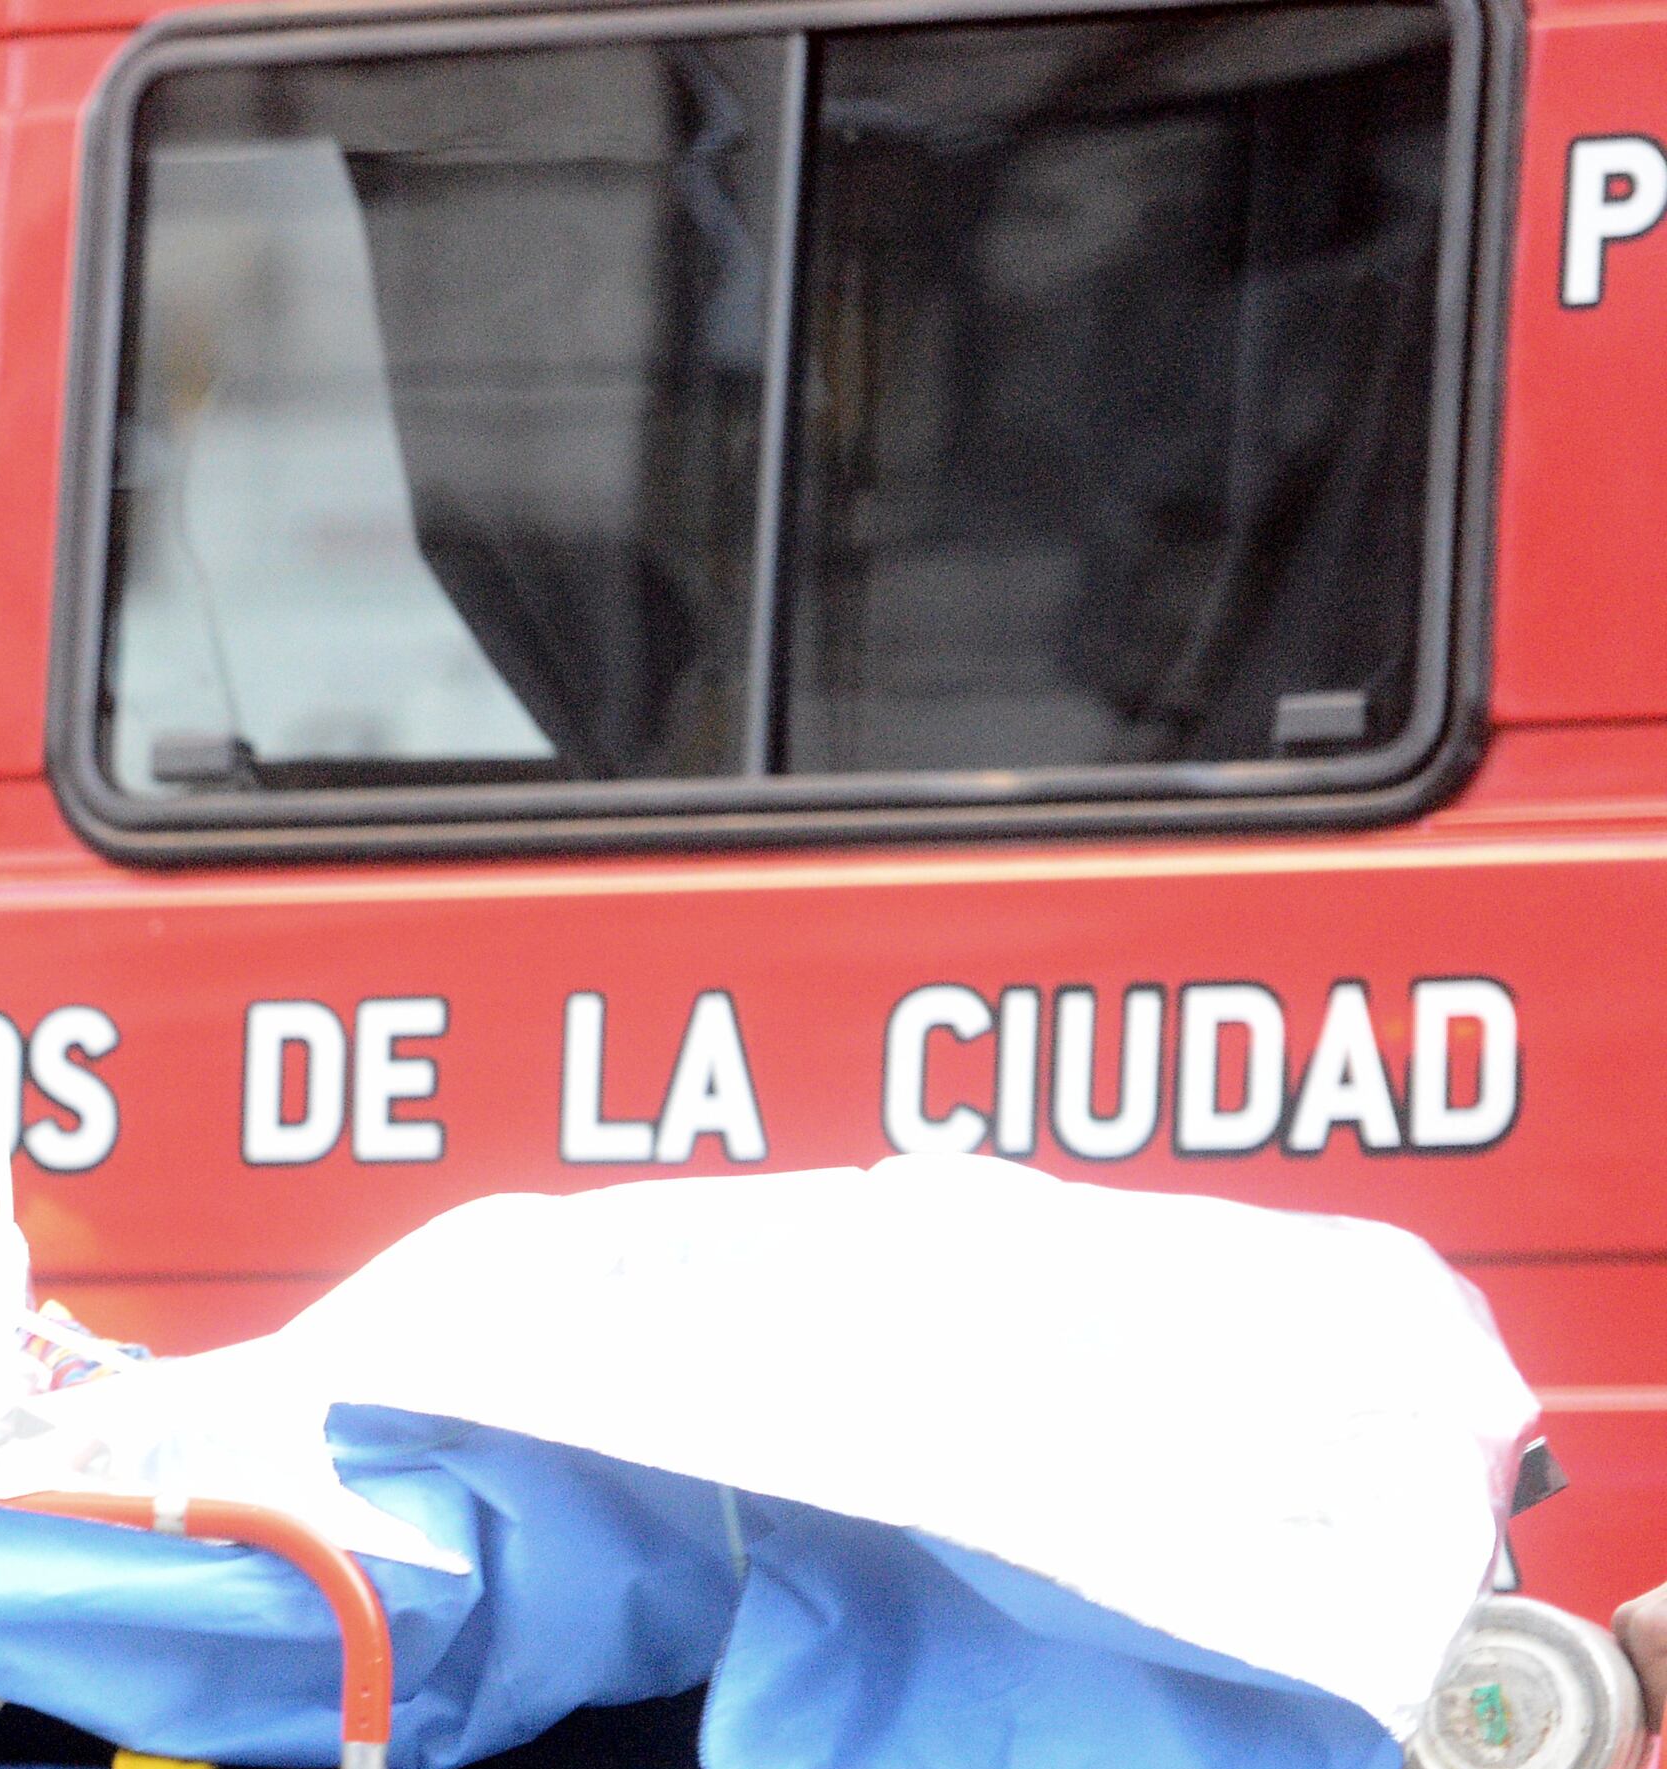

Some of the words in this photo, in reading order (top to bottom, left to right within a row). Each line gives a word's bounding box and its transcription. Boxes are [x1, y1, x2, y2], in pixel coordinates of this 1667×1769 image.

[241, 995, 450, 1165] DE
[559, 989, 769, 1164] LA
[881, 976, 1522, 1161] CIUDAD
